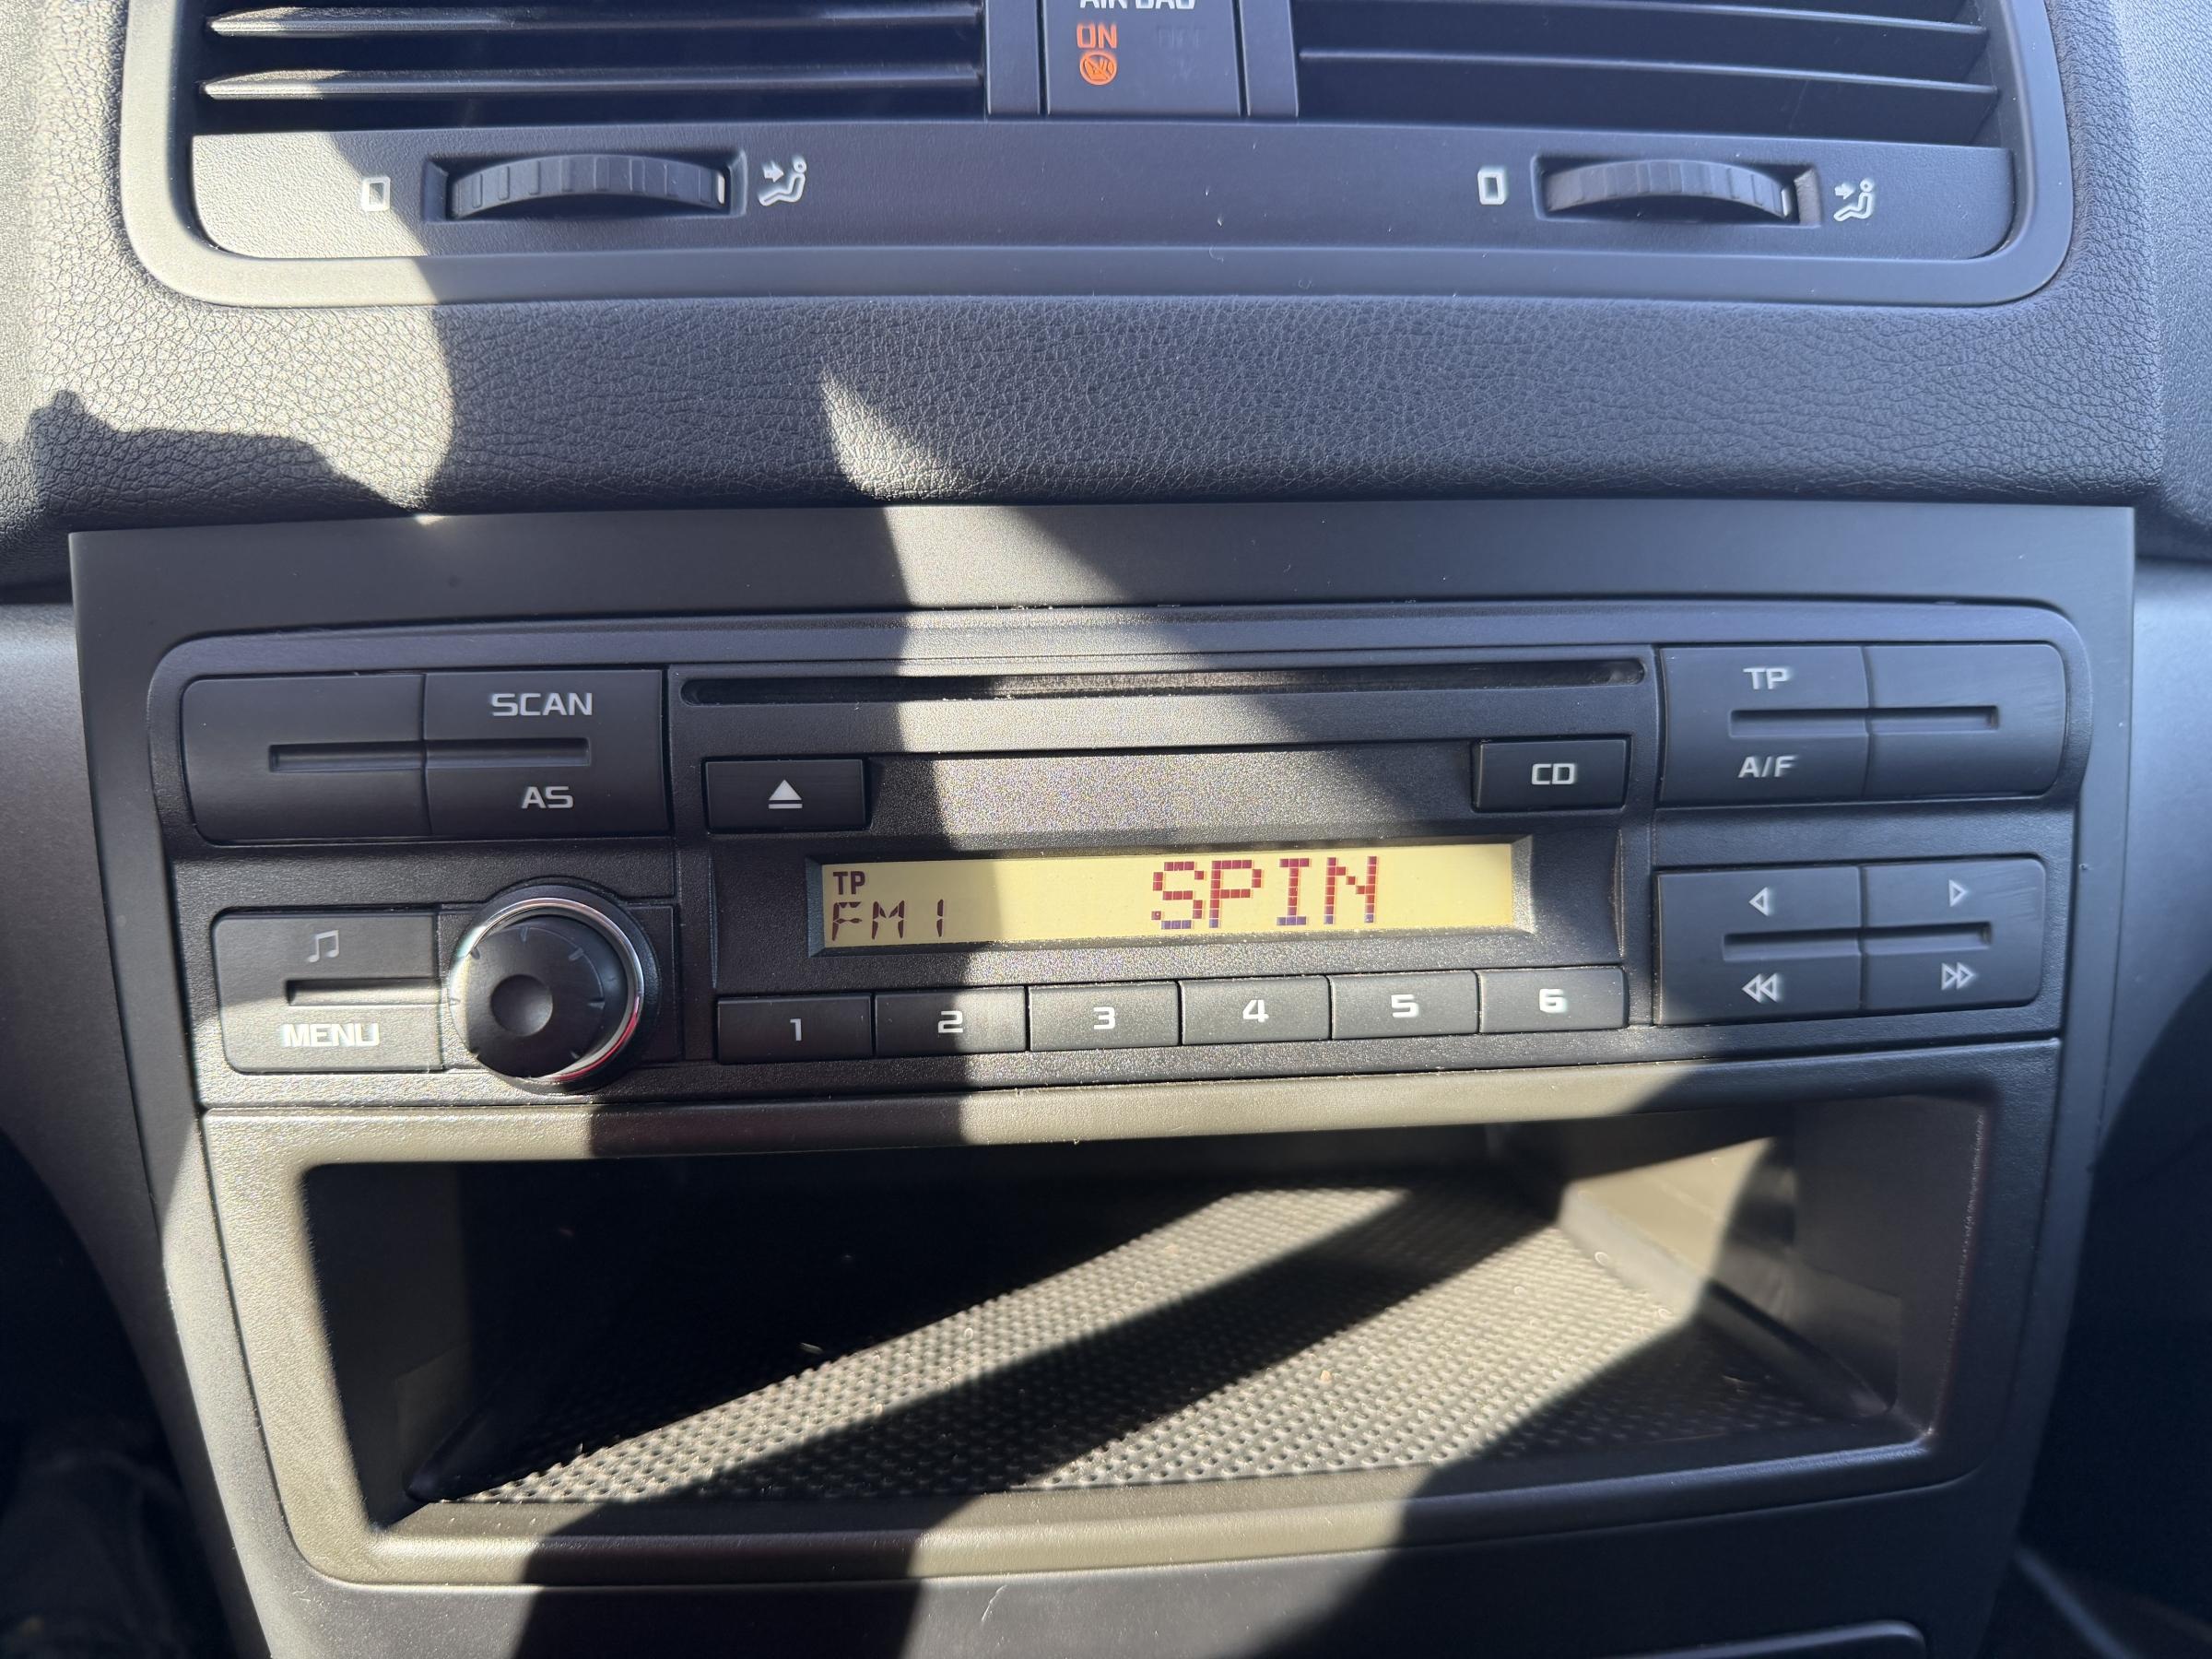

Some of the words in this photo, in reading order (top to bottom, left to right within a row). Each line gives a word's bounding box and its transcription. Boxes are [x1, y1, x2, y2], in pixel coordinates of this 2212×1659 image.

[1077, 23, 1118, 49] ON
[1743, 666, 1792, 690] TP
[490, 692, 593, 717] SCAN
[1531, 762, 1576, 785] CD
[1738, 755, 1796, 778] A/F
[521, 785, 573, 809] AS
[832, 871, 865, 895] TP
[1151, 855, 1377, 929] SPIN
[1242, 999, 1270, 1023] 4
[1391, 994, 1419, 1018] 5
[1538, 988, 1568, 1014] 6
[789, 1018, 803, 1041] 1
[937, 1010, 964, 1034] 2
[1092, 1006, 1116, 1030] 3
[281, 1022, 380, 1047] MENU
